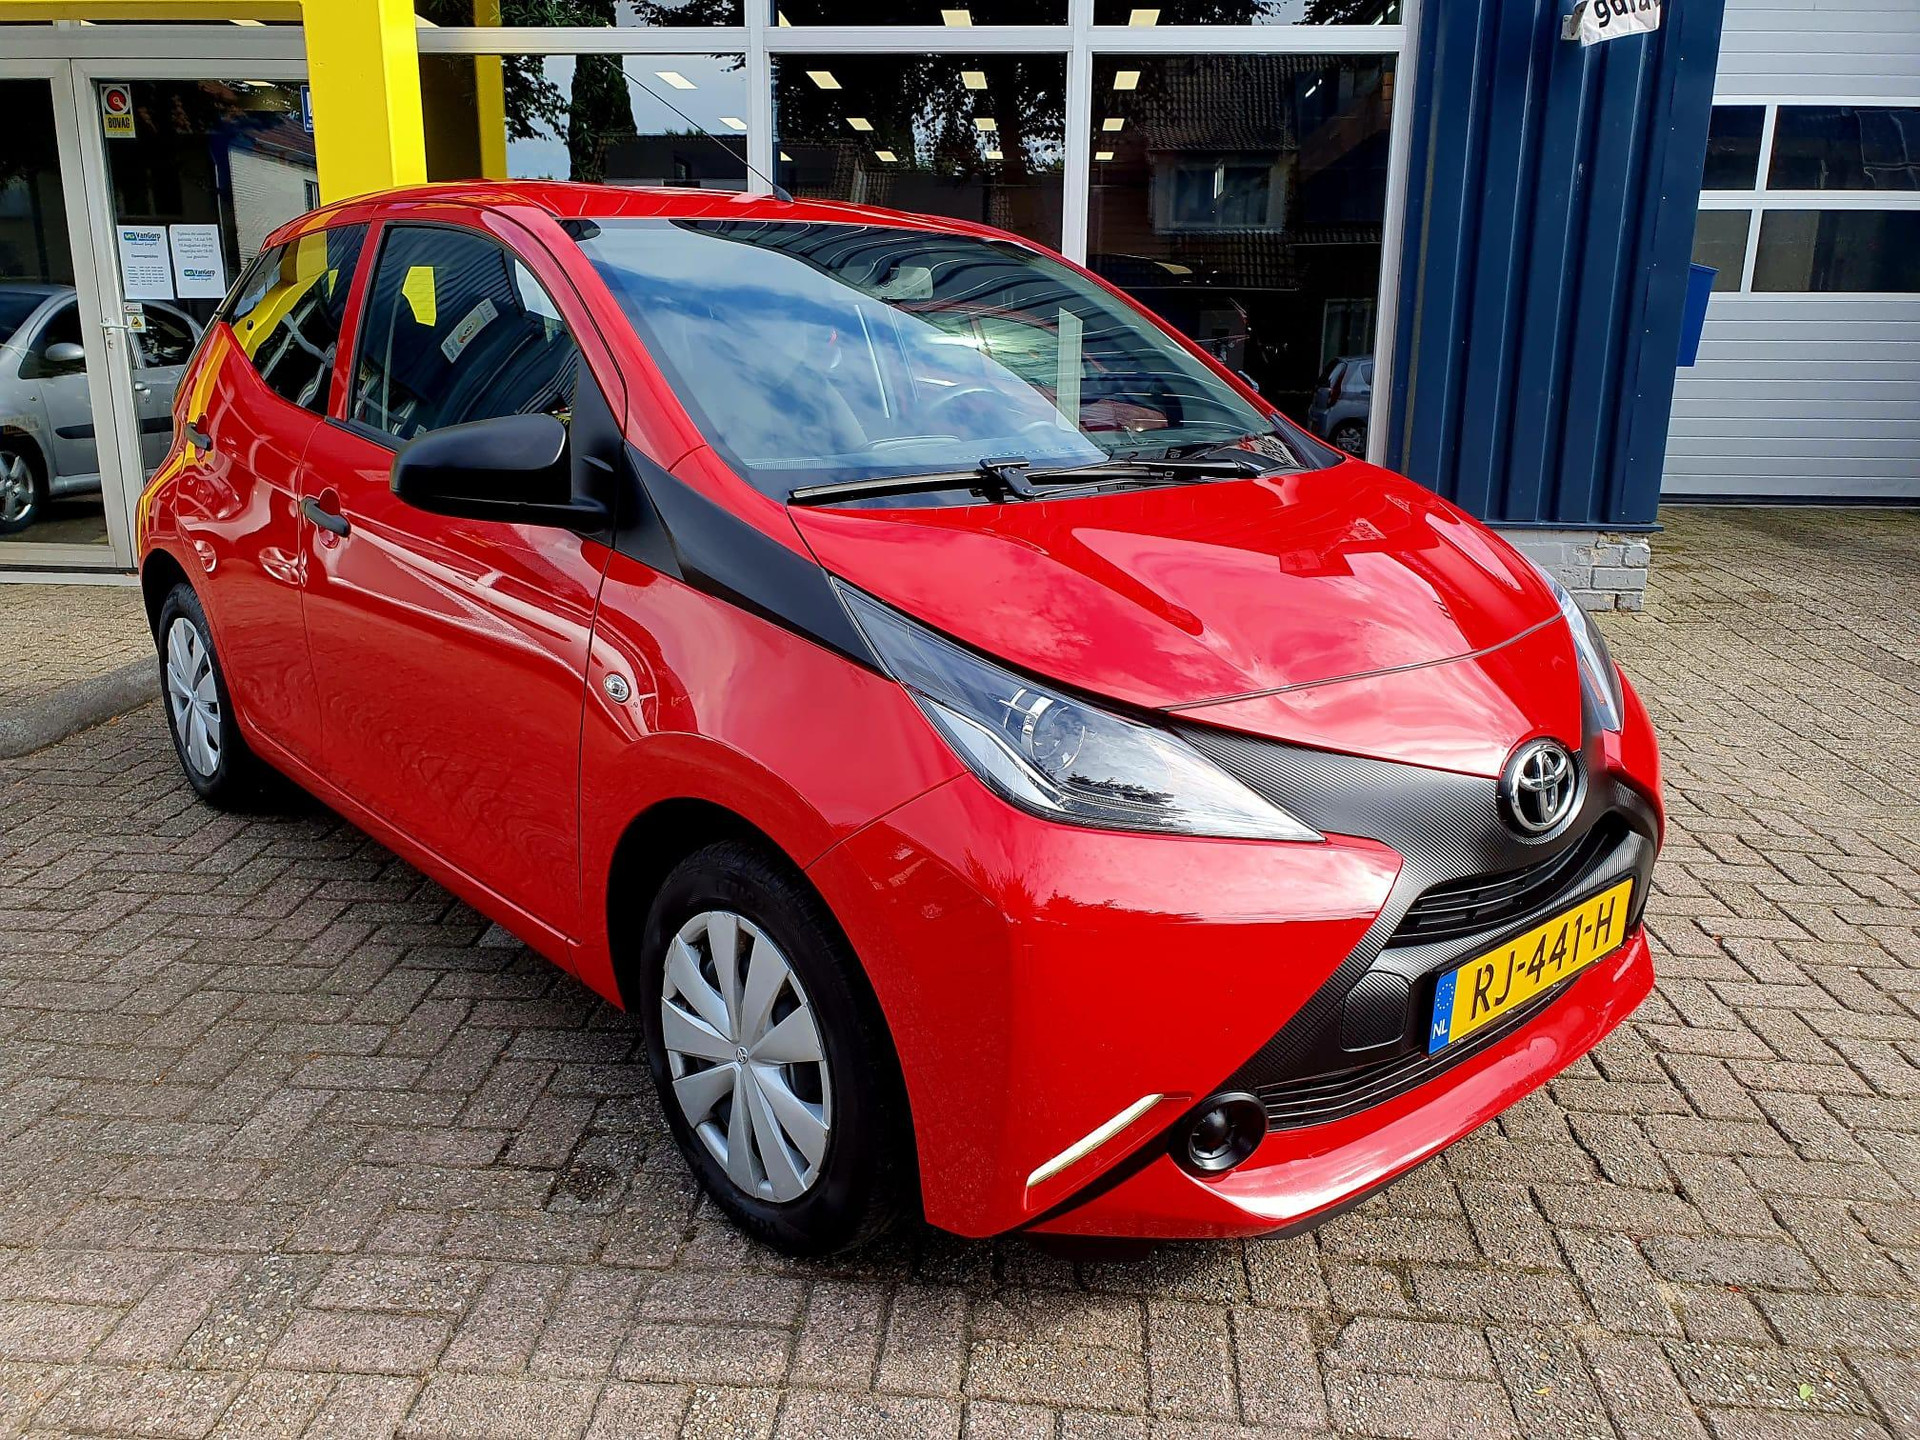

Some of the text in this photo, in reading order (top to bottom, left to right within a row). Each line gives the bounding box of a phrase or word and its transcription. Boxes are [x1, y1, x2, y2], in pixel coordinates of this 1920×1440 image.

[108, 116, 130, 129] BOVAG
[136, 231, 161, 242] VanGorp
[1470, 896, 1616, 1022] RJ-441-H
[1432, 1019, 1448, 1040] NL
